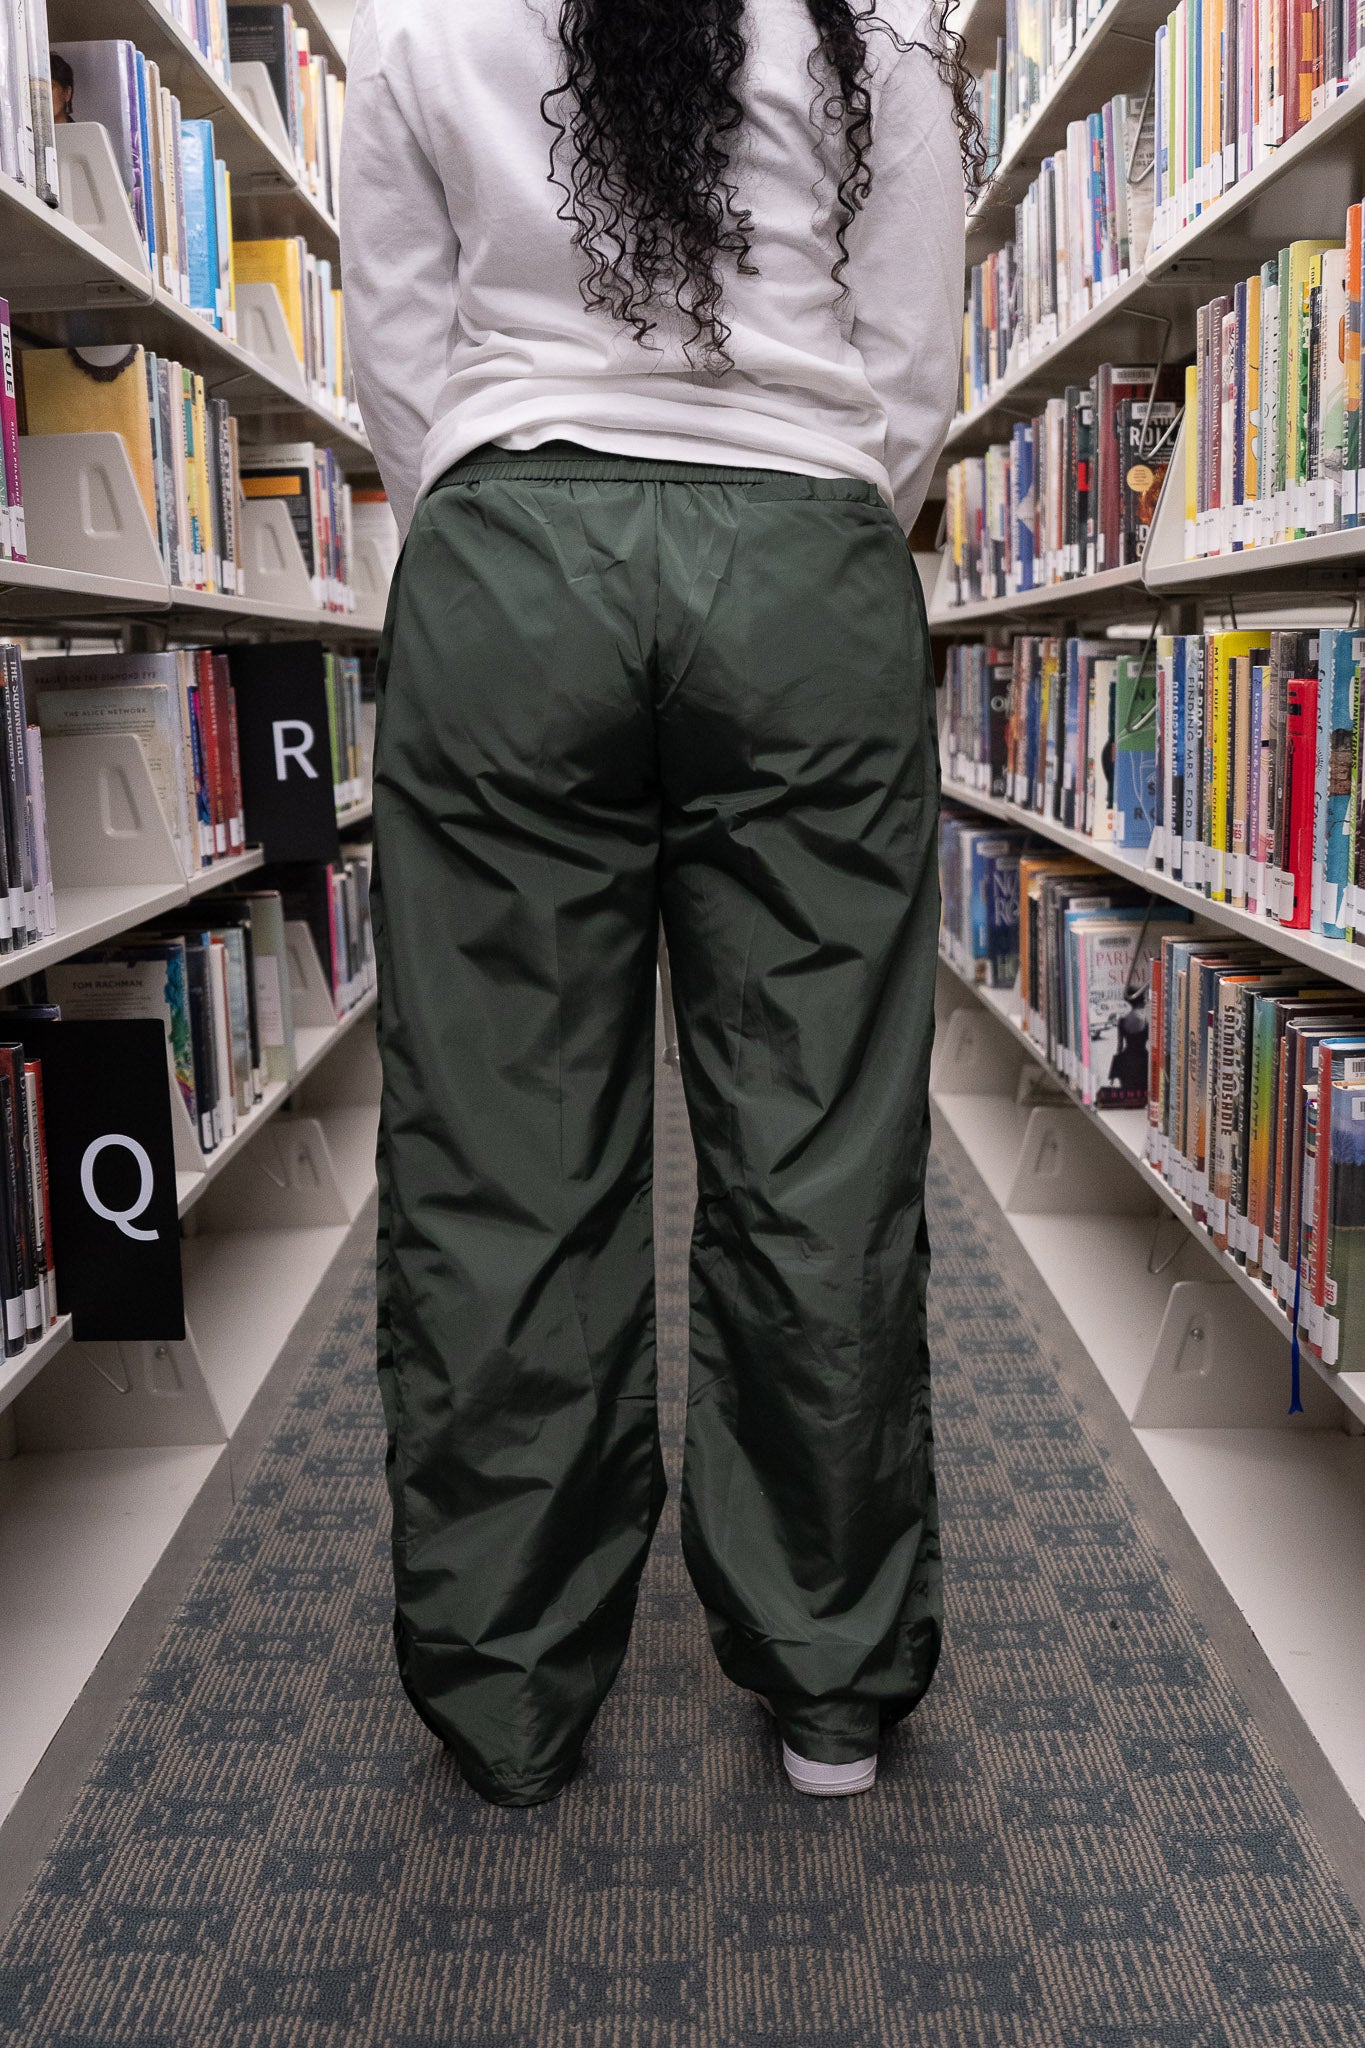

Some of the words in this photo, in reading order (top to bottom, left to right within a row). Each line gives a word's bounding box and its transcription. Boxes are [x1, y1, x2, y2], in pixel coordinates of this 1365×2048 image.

[1212, 306, 1221, 345] Philip
[3, 330, 14, 394] TRUE
[1213, 347, 1221, 377] Roth
[1212, 383, 1221, 441] Sabbath's
[1211, 441, 1220, 492] Theater
[12, 685, 25, 765] SQUANDERED
[64, 709, 80, 718] THE
[108, 706, 147, 716] NETWORK
[1187, 677, 1195, 743] FINDING
[272, 718, 319, 782] R
[1185, 789, 1193, 828] FORD
[1250, 771, 1258, 807] Fancy
[1224, 1005, 1236, 1067] SALMAN
[1221, 1072, 1233, 1136] RUSHDIE
[80, 1133, 160, 1242] Q
